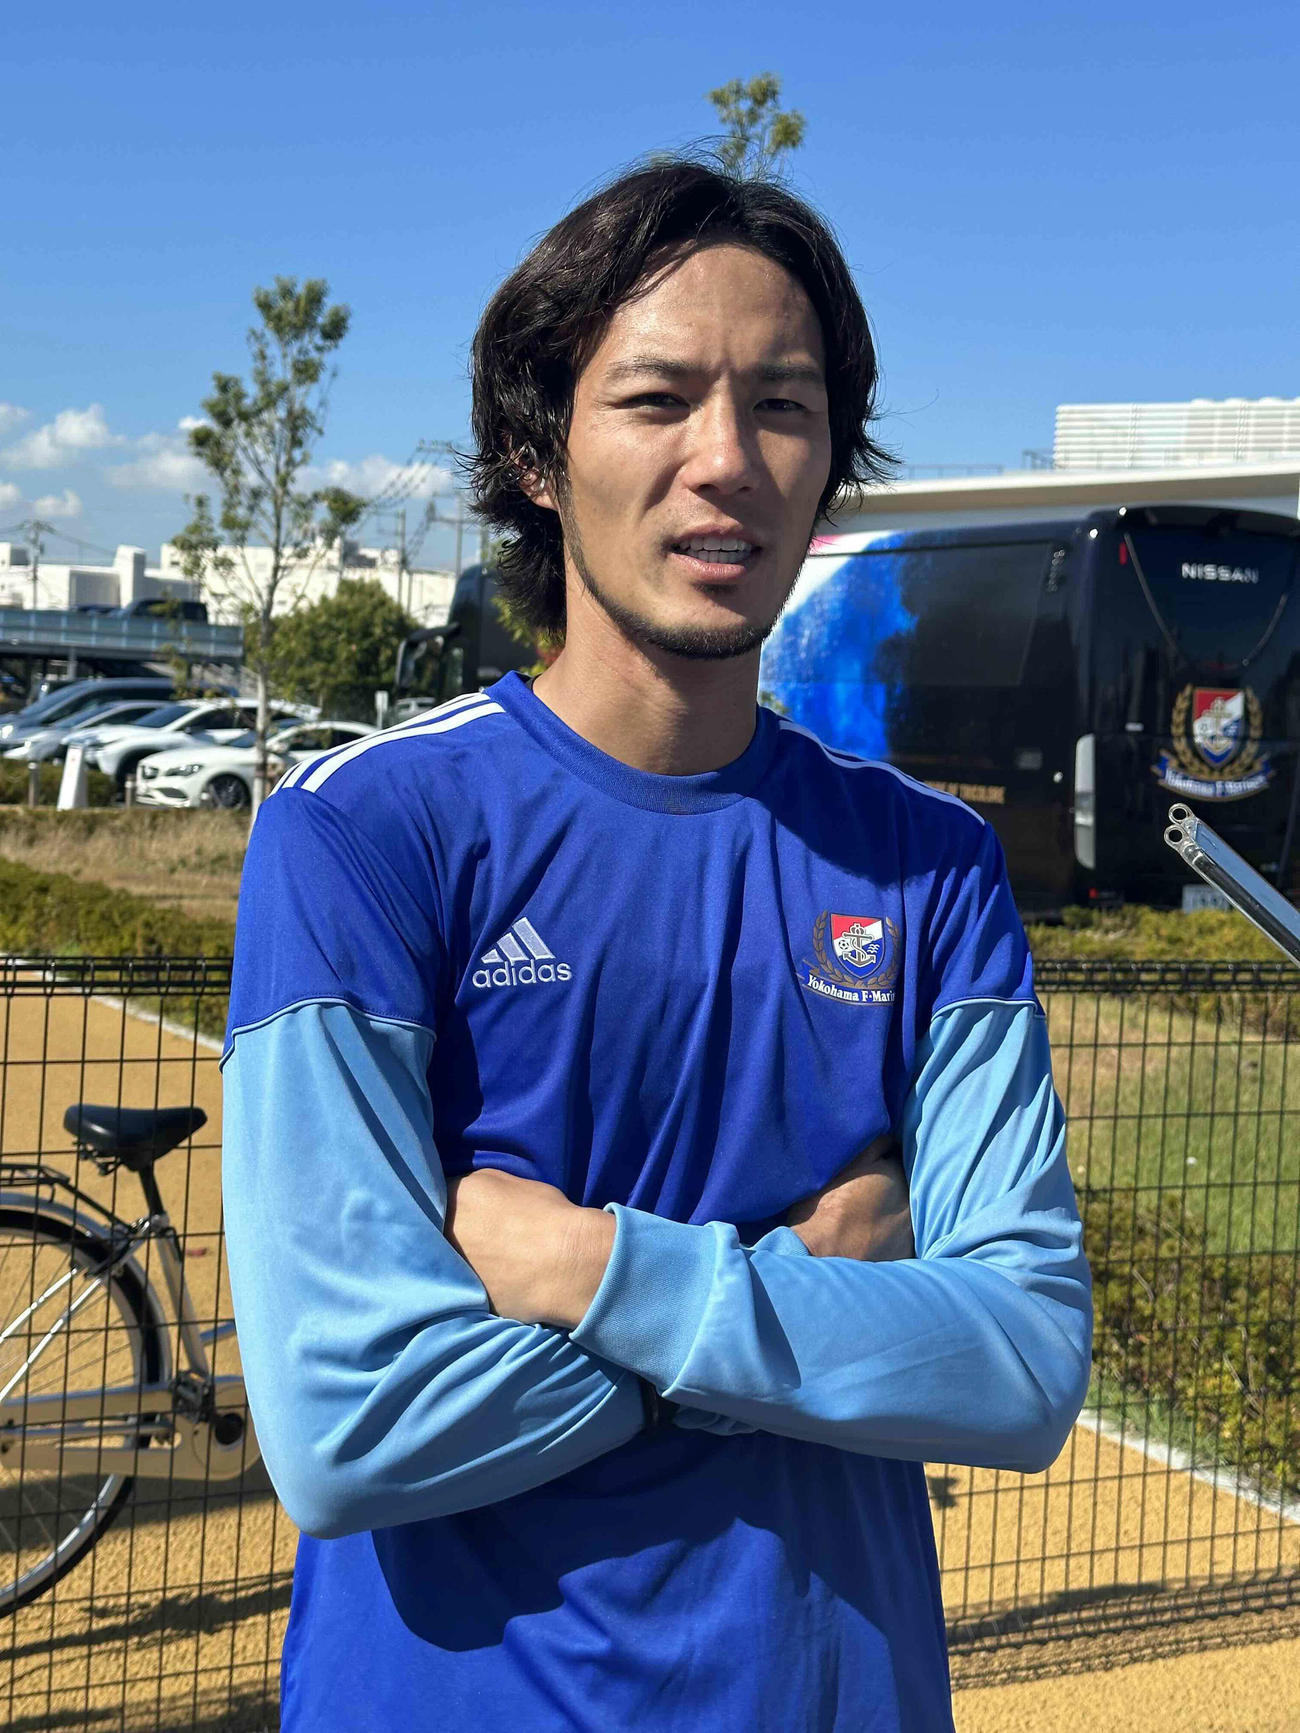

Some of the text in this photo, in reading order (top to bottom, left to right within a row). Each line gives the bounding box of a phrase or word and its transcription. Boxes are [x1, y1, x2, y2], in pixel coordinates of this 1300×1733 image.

[1181, 562, 1259, 583] NISSAN
[472, 959, 572, 988] adidas
[807, 974, 859, 1001] Yokohama
